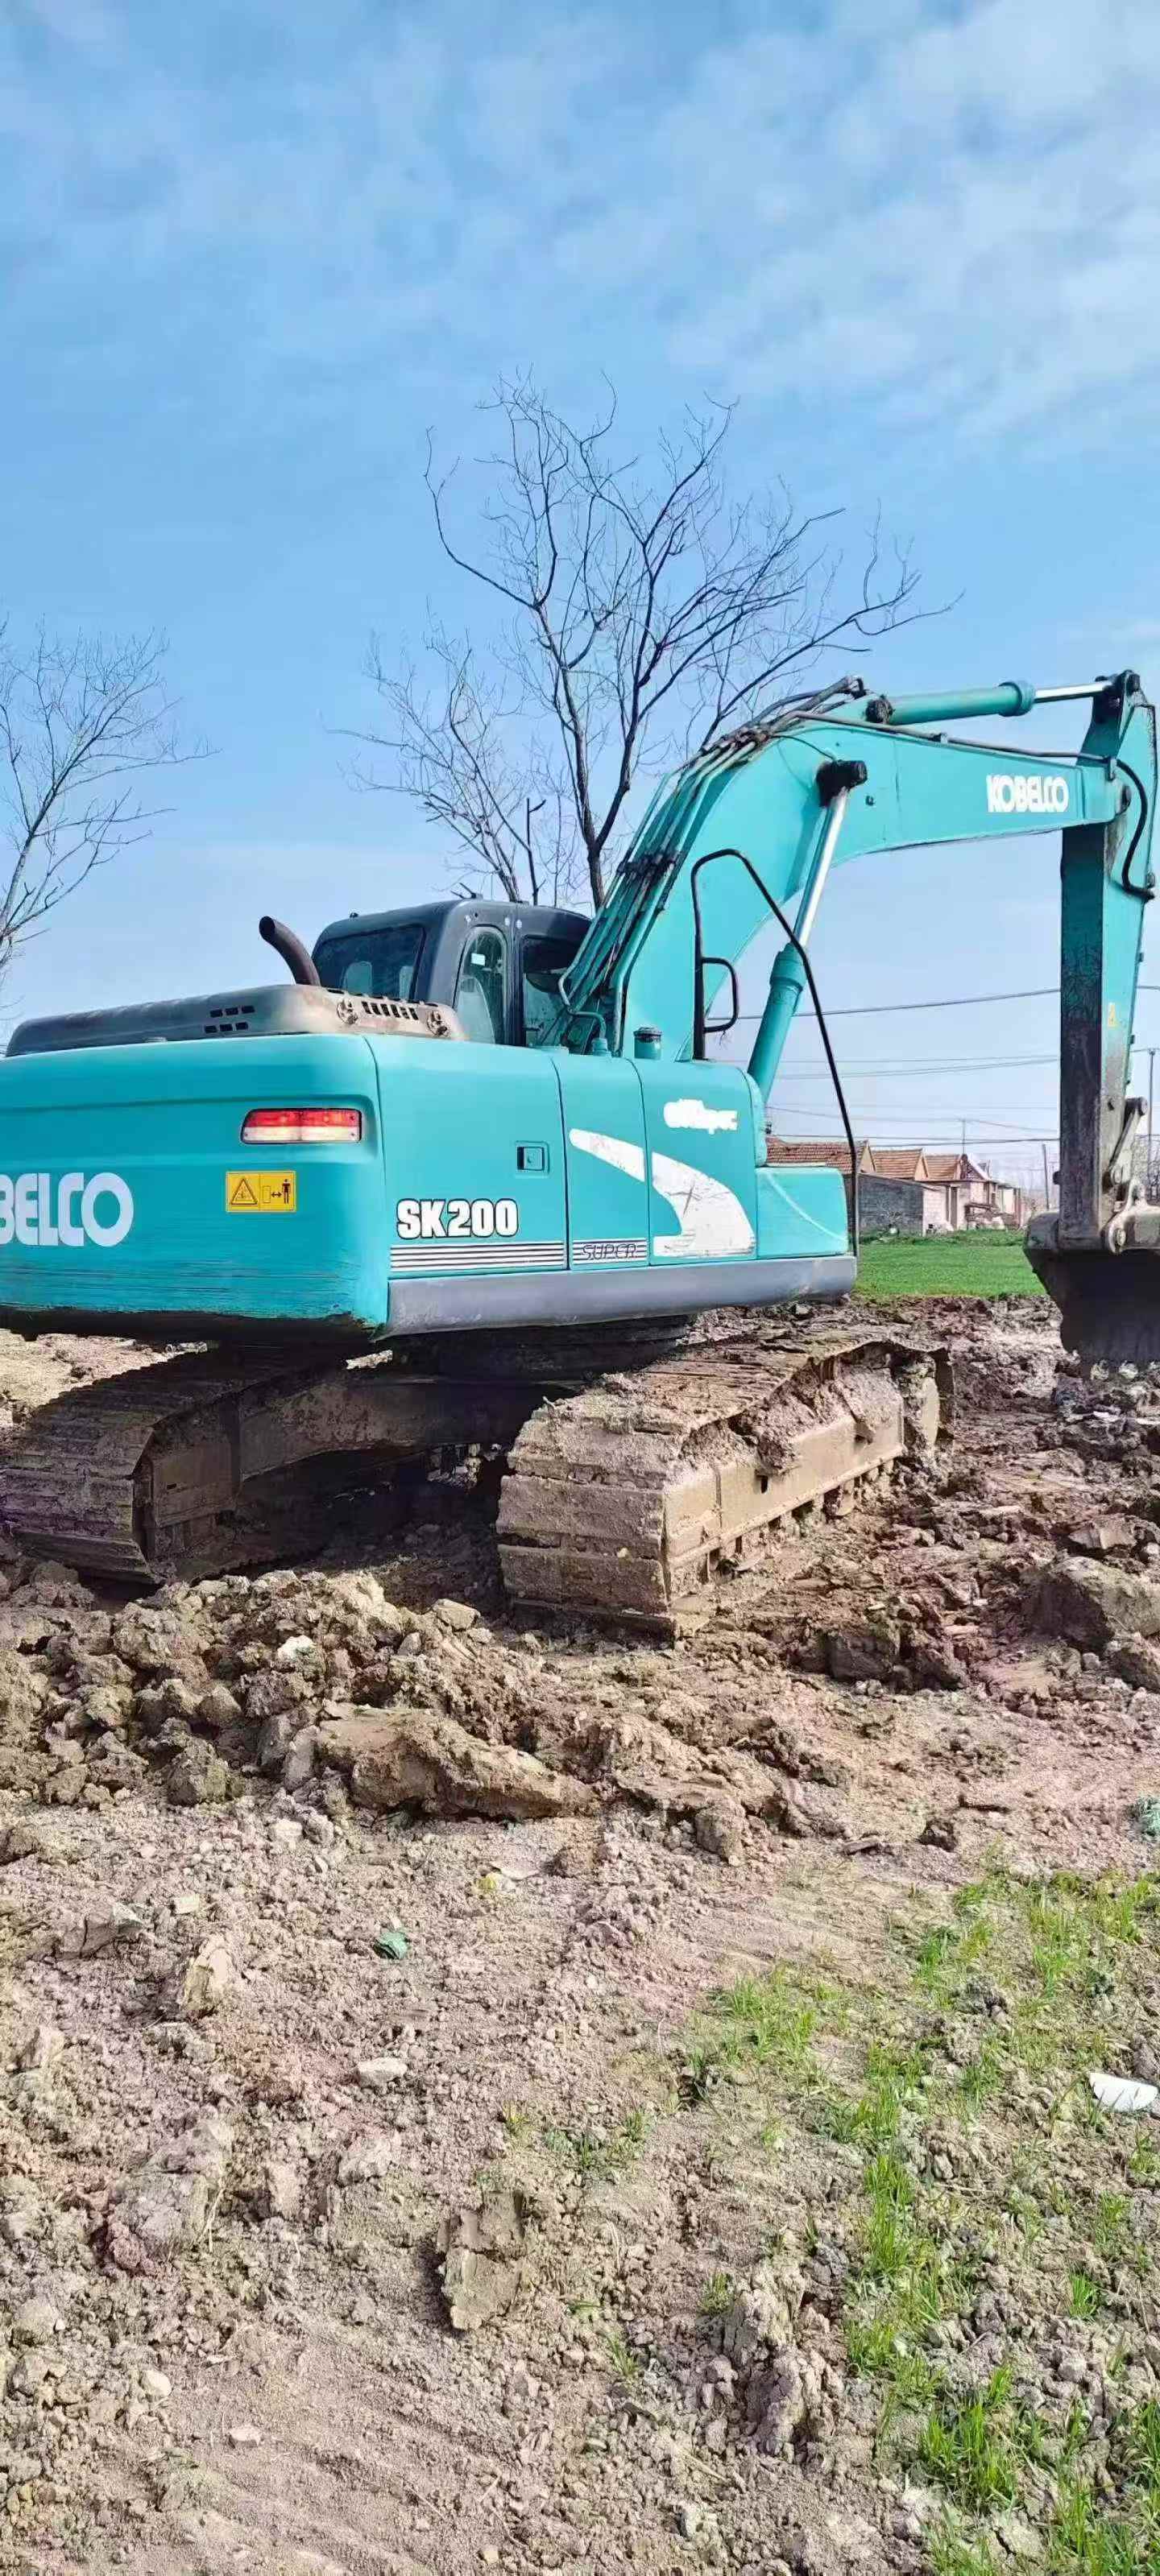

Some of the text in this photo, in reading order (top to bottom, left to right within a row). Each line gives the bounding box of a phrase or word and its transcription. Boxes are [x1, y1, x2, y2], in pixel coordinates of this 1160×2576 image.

[986, 775, 1069, 812] KOBELCO
[396, 1198, 520, 1240] SK200
[581, 1243, 638, 1261] SUPER
